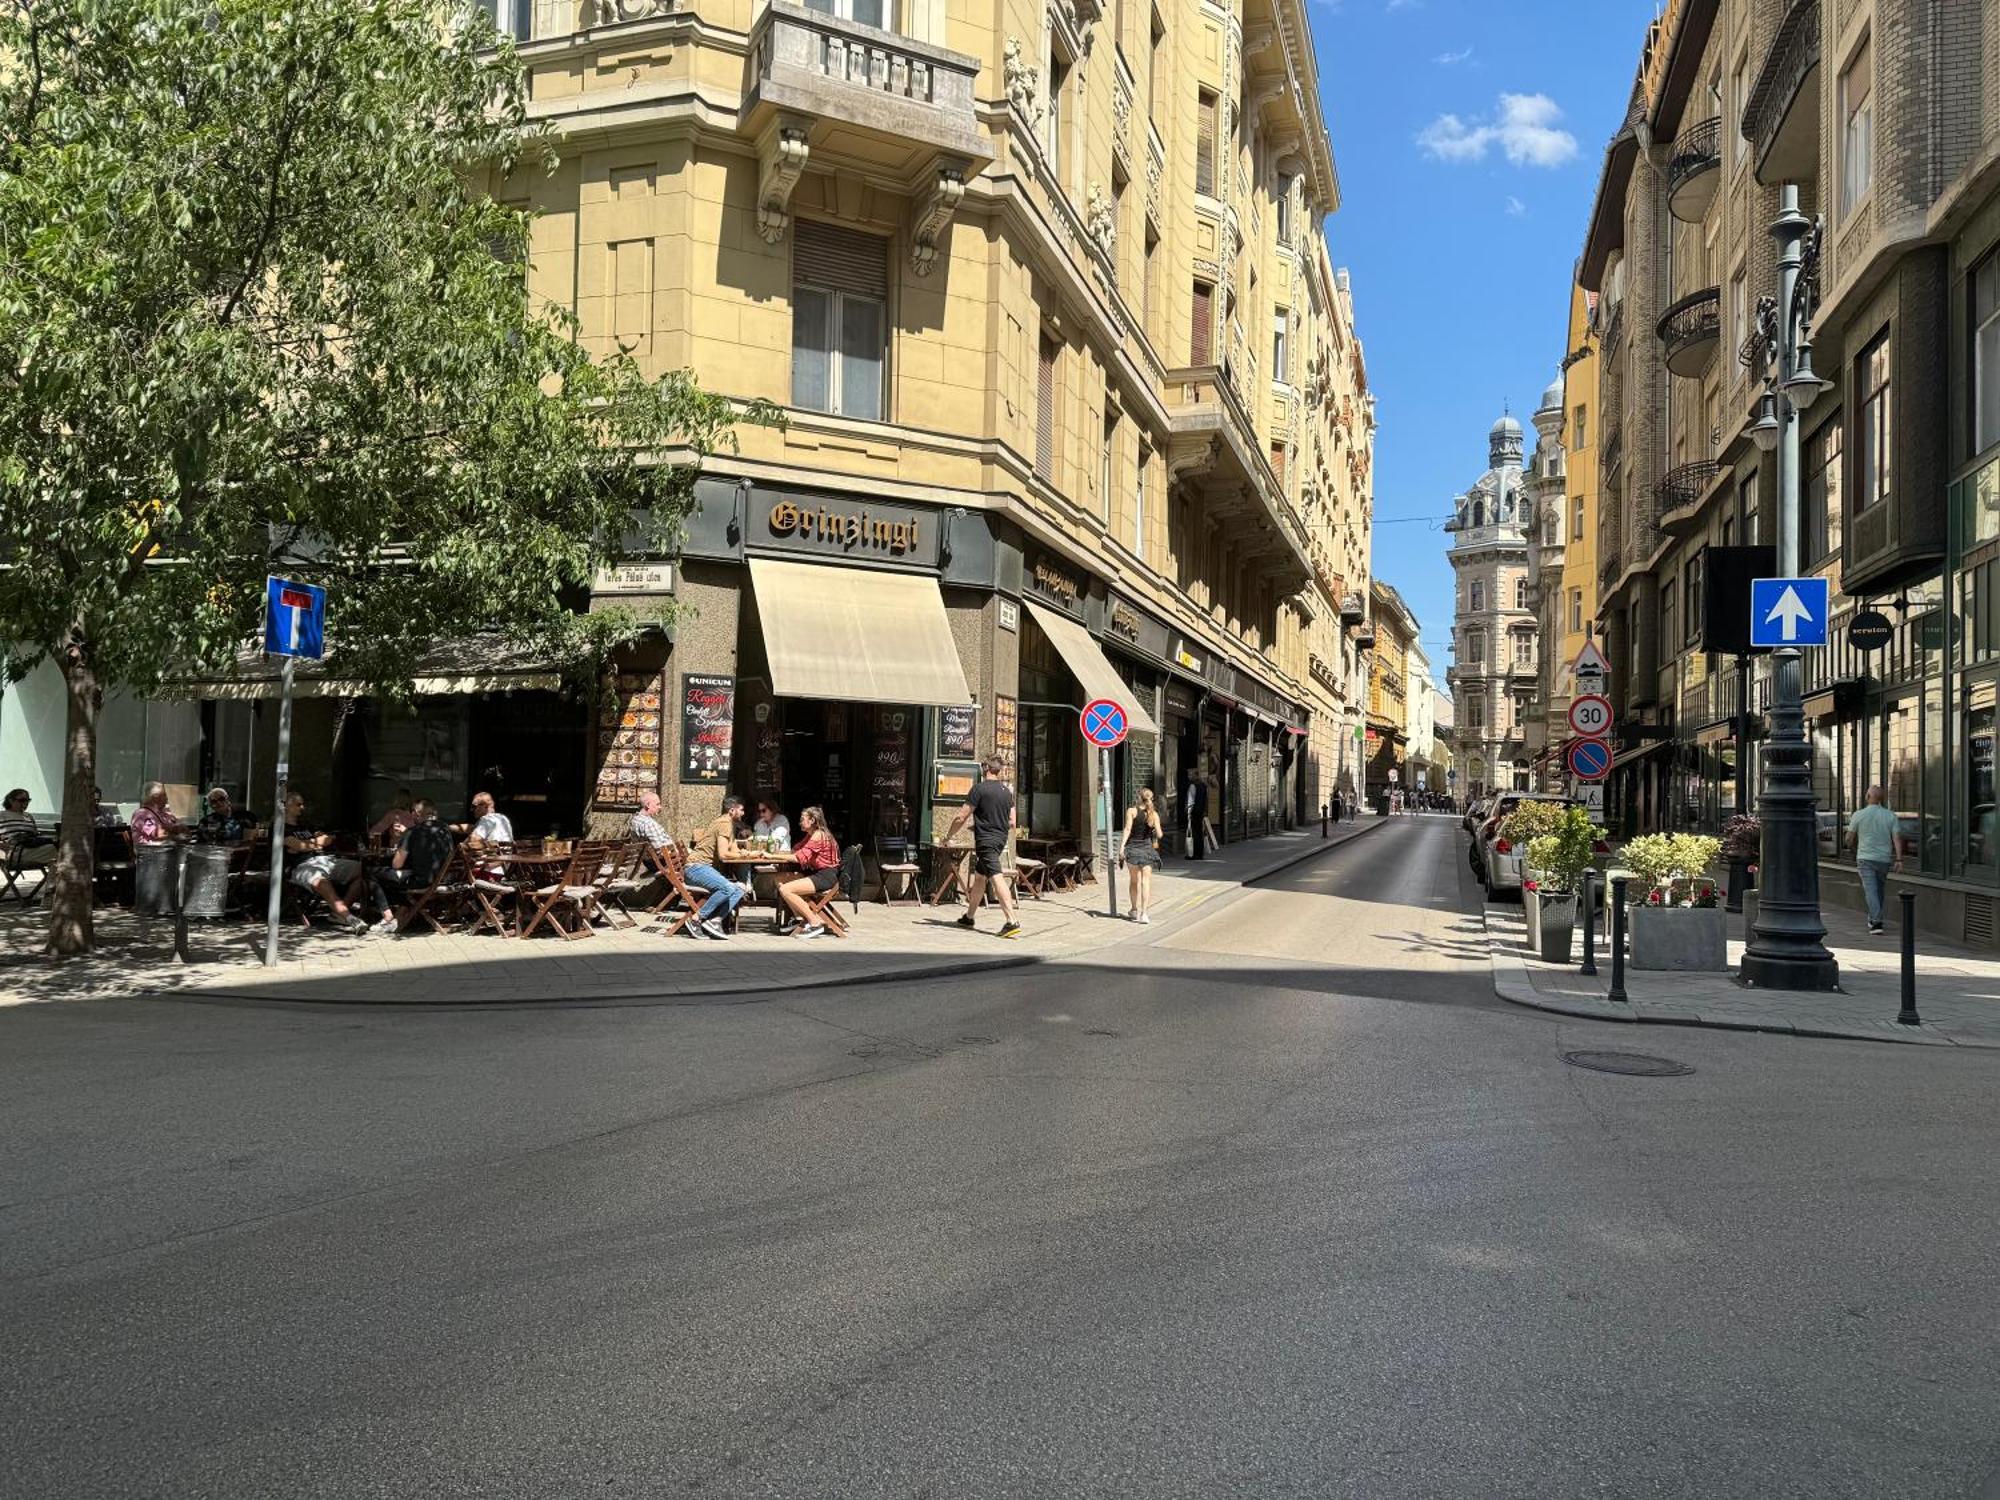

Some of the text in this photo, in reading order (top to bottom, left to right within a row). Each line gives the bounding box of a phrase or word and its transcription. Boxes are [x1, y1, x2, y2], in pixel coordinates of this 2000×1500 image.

[770, 500, 919, 548] Grinzingi
[696, 677, 731, 686] UNICUM
[1580, 708, 1601, 724] 30
